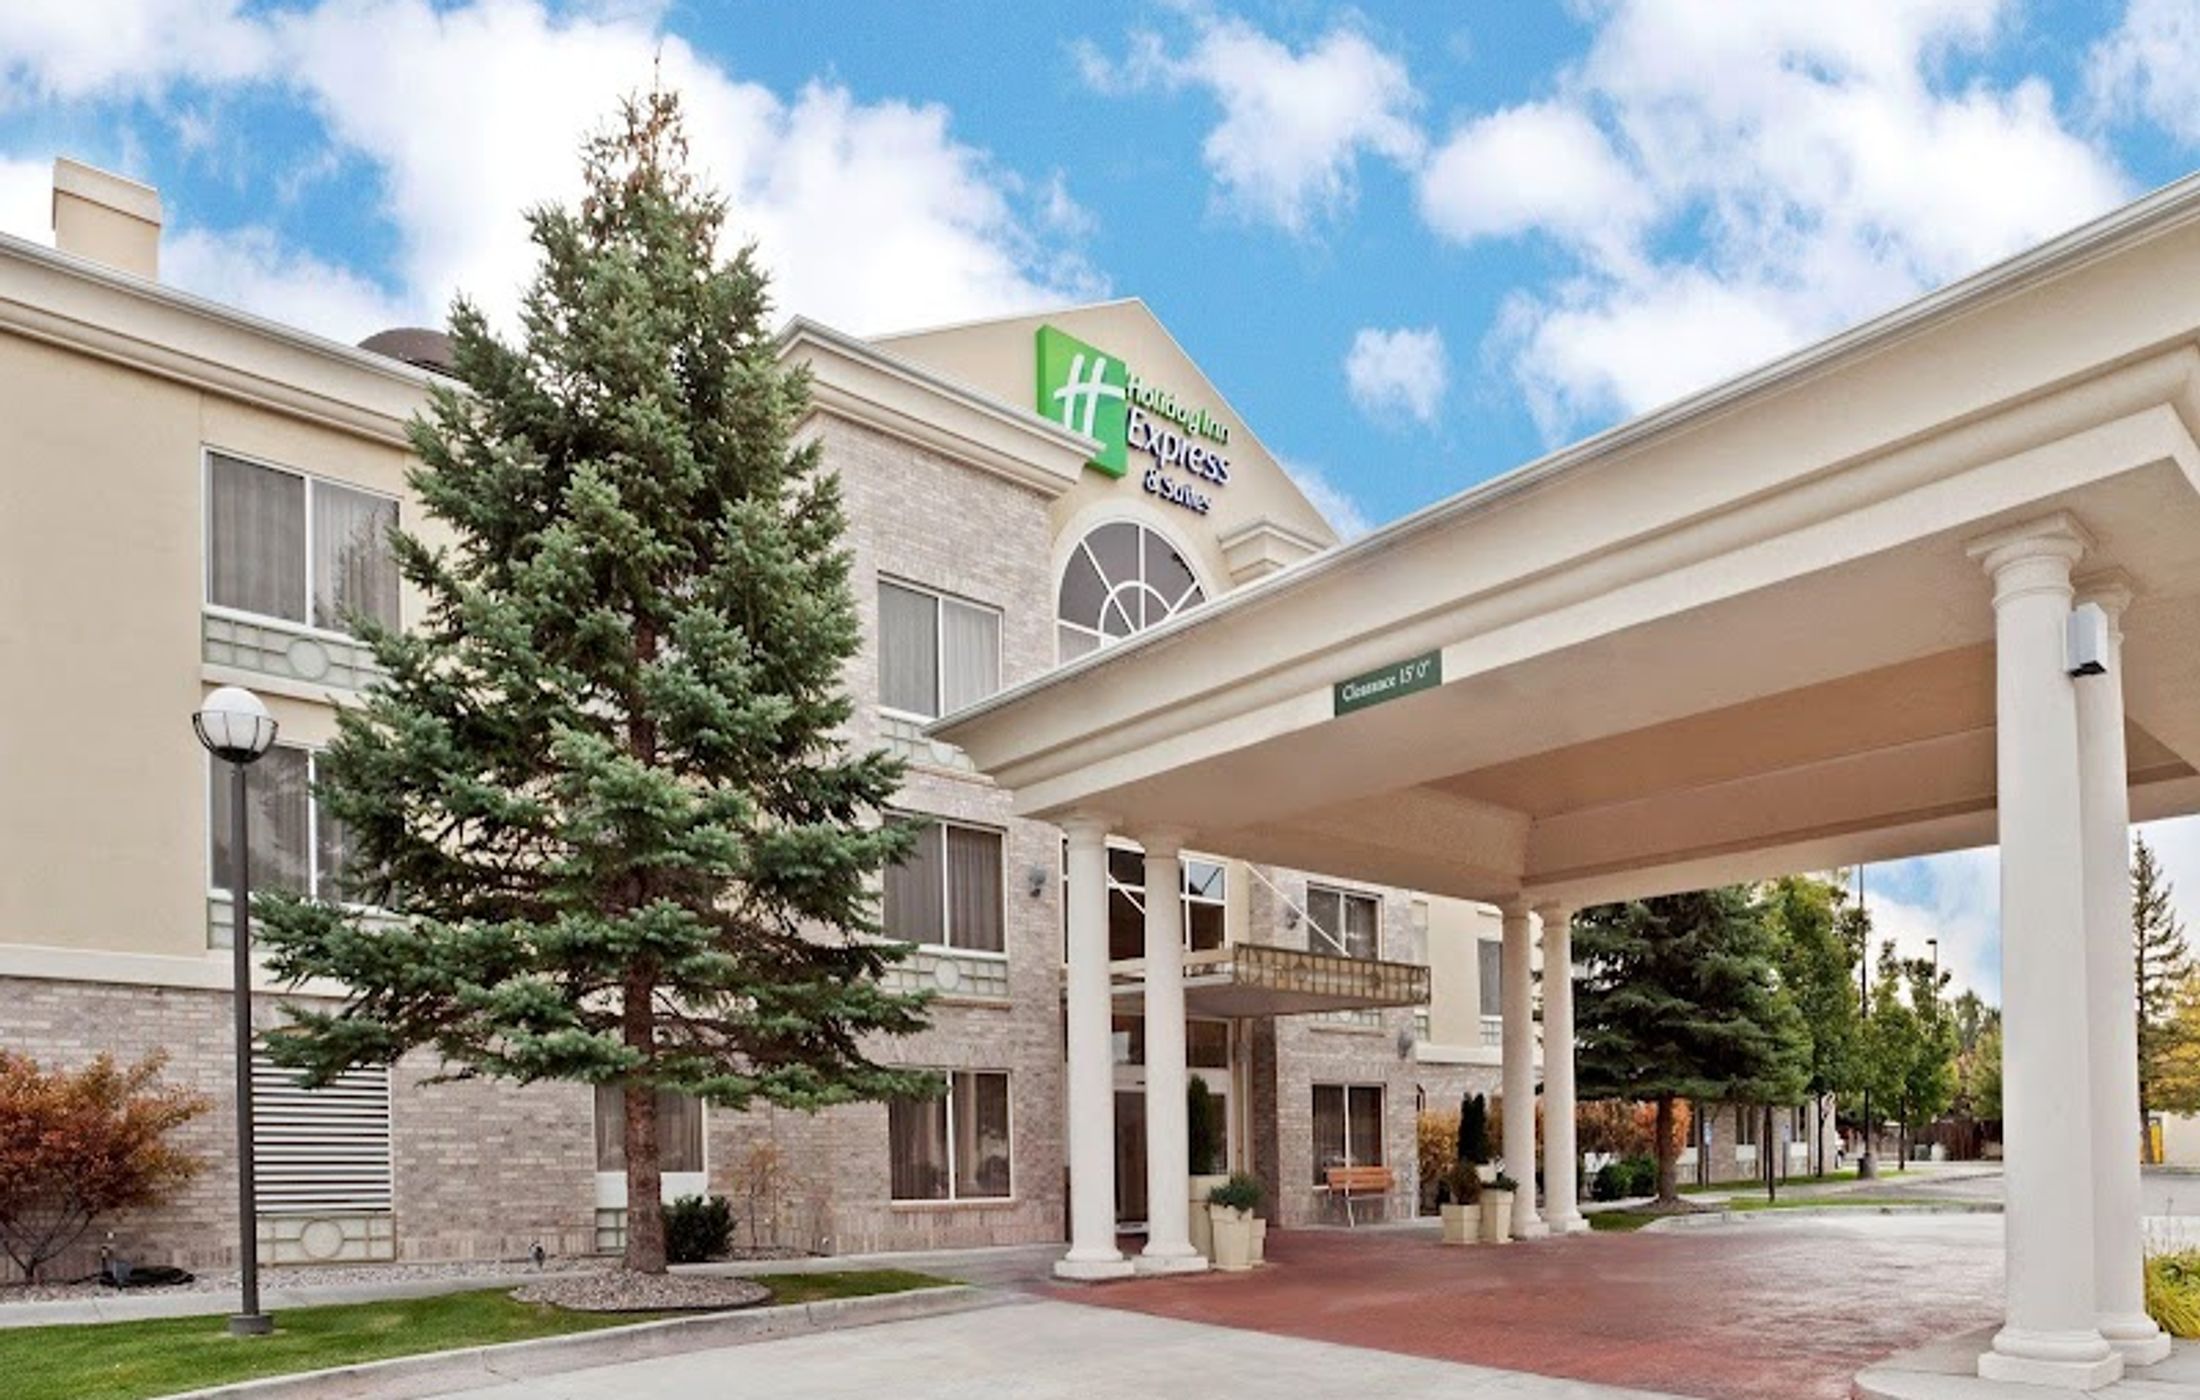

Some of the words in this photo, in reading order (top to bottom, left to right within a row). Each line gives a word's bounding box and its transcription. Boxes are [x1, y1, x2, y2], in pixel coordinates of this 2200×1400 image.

[1126, 372, 1200, 434] Holiday
[1201, 408, 1231, 444] Inn
[1127, 405, 1231, 486] Express
[1160, 477, 1212, 512] Suites
